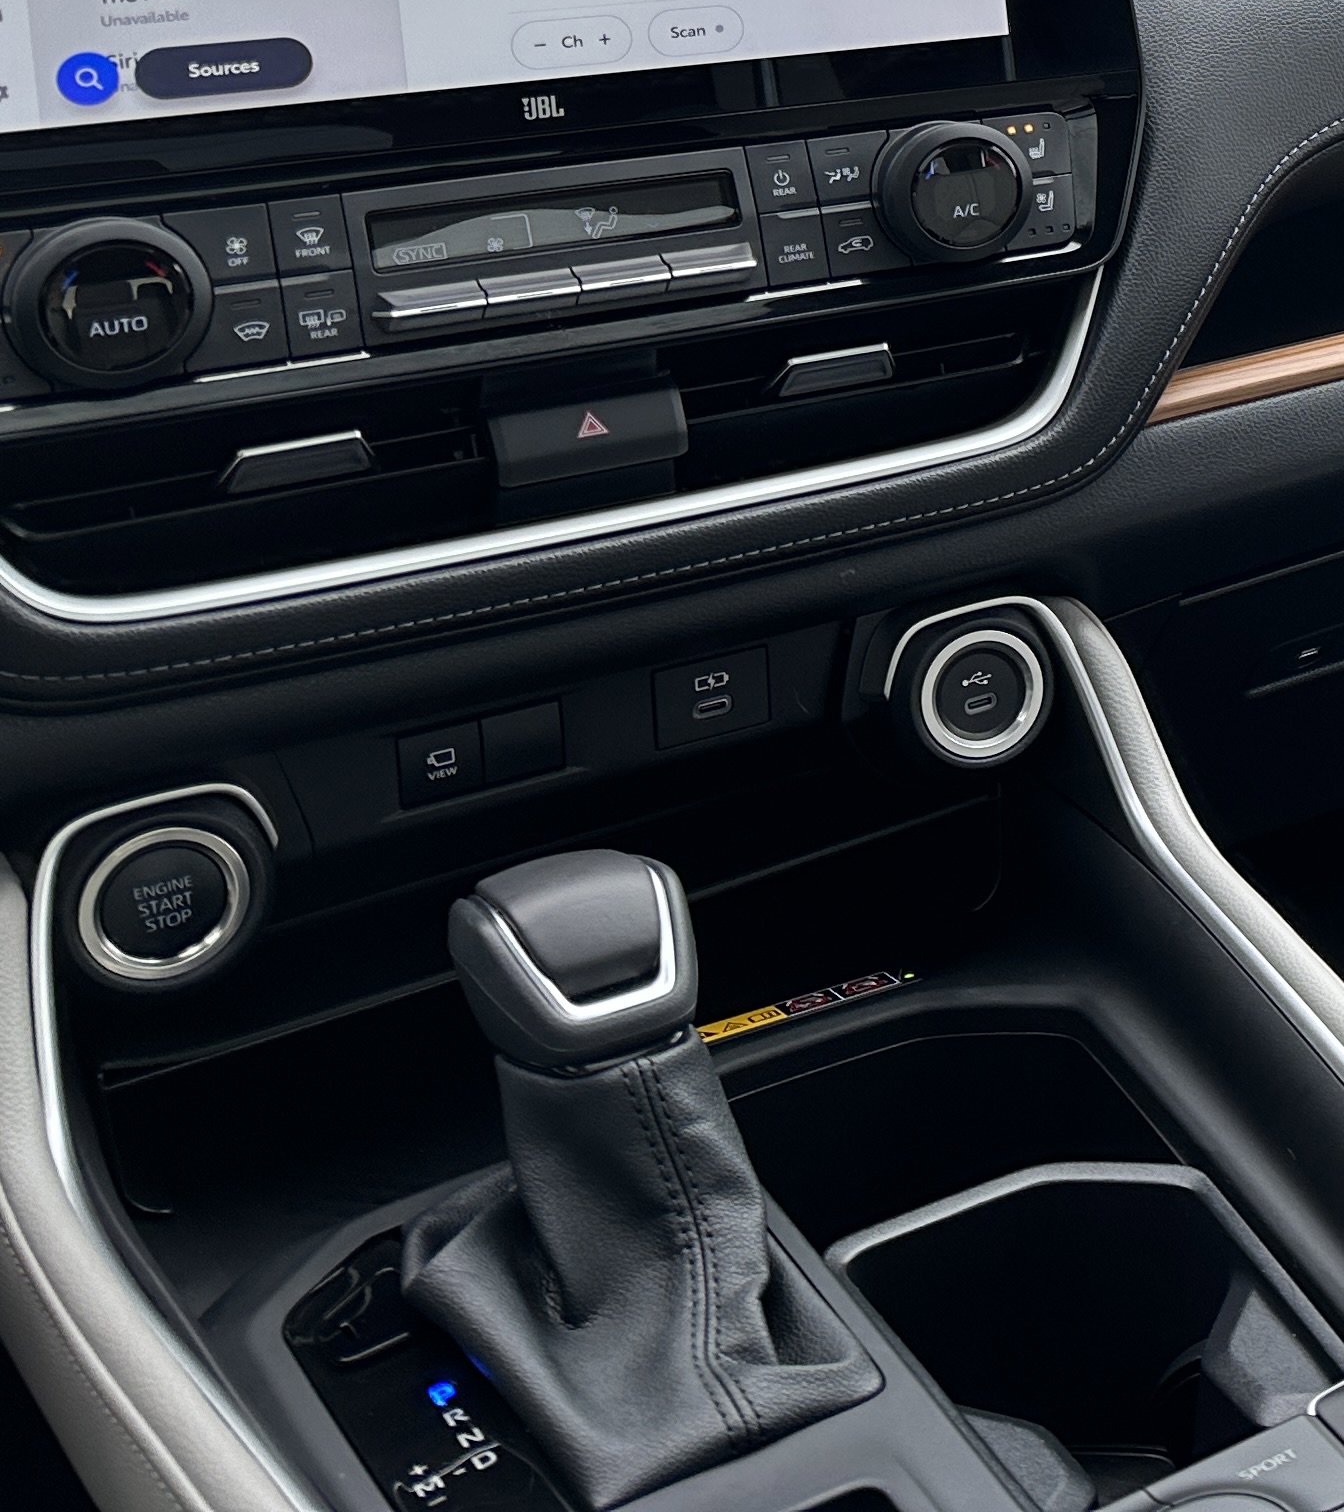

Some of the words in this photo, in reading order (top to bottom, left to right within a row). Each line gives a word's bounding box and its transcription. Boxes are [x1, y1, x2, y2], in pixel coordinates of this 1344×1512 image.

[100, 8, 190, 28] Unavailable
[561, 33, 584, 50] Ch
[670, 24, 706, 40] Scan
[188, 58, 260, 78] Sources
[521, 94, 565, 121] JBL
[773, 187, 797, 197] REAR
[953, 202, 980, 219] A/C
[295, 244, 331, 259] FRONT
[399, 244, 444, 264] SYNC
[778, 251, 815, 264] CLIMATE
[783, 243, 808, 254] REAR
[227, 255, 250, 268] OFF
[89, 315, 149, 338] AUTO
[310, 327, 338, 340] REAR
[426, 765, 458, 781] VIEW
[133, 875, 194, 901] ENGINE
[138, 891, 192, 917] START
[145, 908, 193, 933] STOP
[428, 1381, 457, 1407] P
[442, 1408, 471, 1427] R
[456, 1427, 486, 1449] N
[470, 1450, 498, 1471] D
[1236, 1447, 1298, 1481] SPORT
[412, 1475, 446, 1498] M
